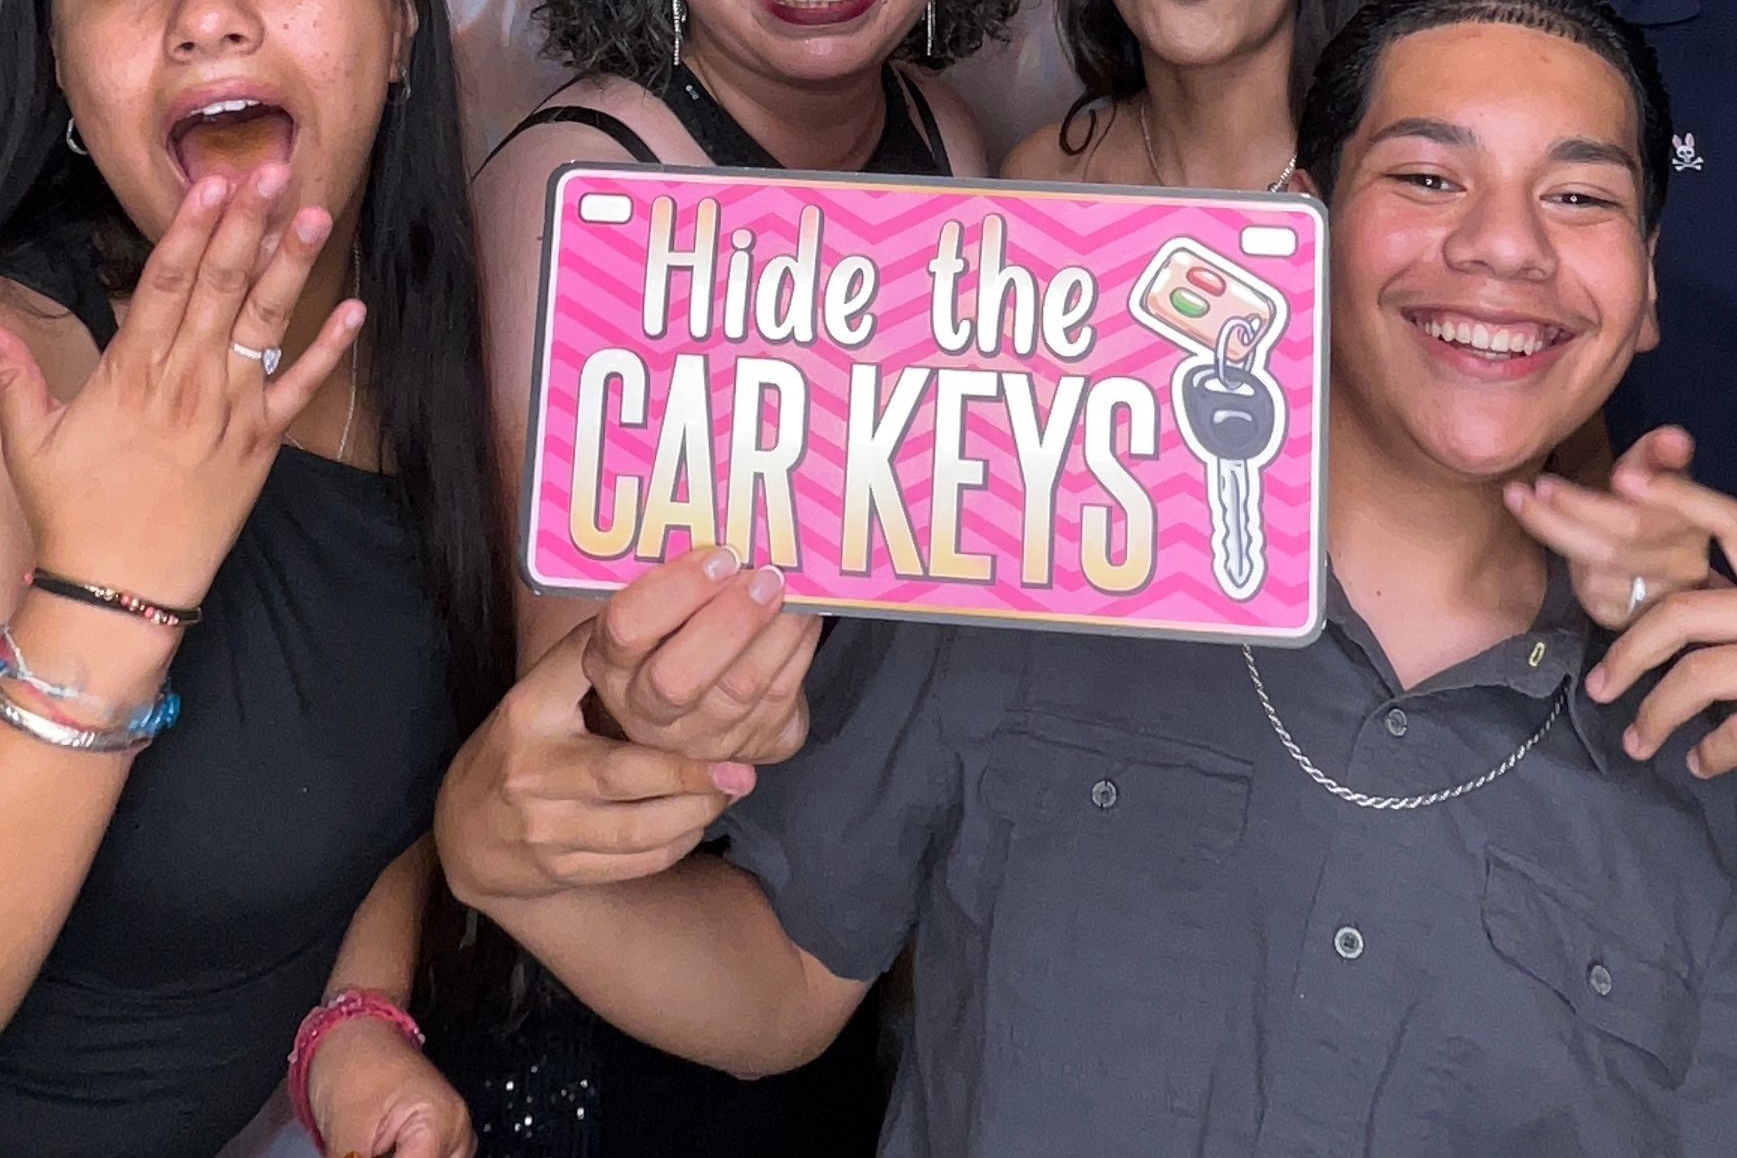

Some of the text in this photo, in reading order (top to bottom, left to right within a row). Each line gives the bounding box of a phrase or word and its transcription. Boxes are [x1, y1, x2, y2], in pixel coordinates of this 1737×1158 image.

[642, 195, 1096, 359] Hide the
[568, 347, 1159, 594] CAR KEYS
